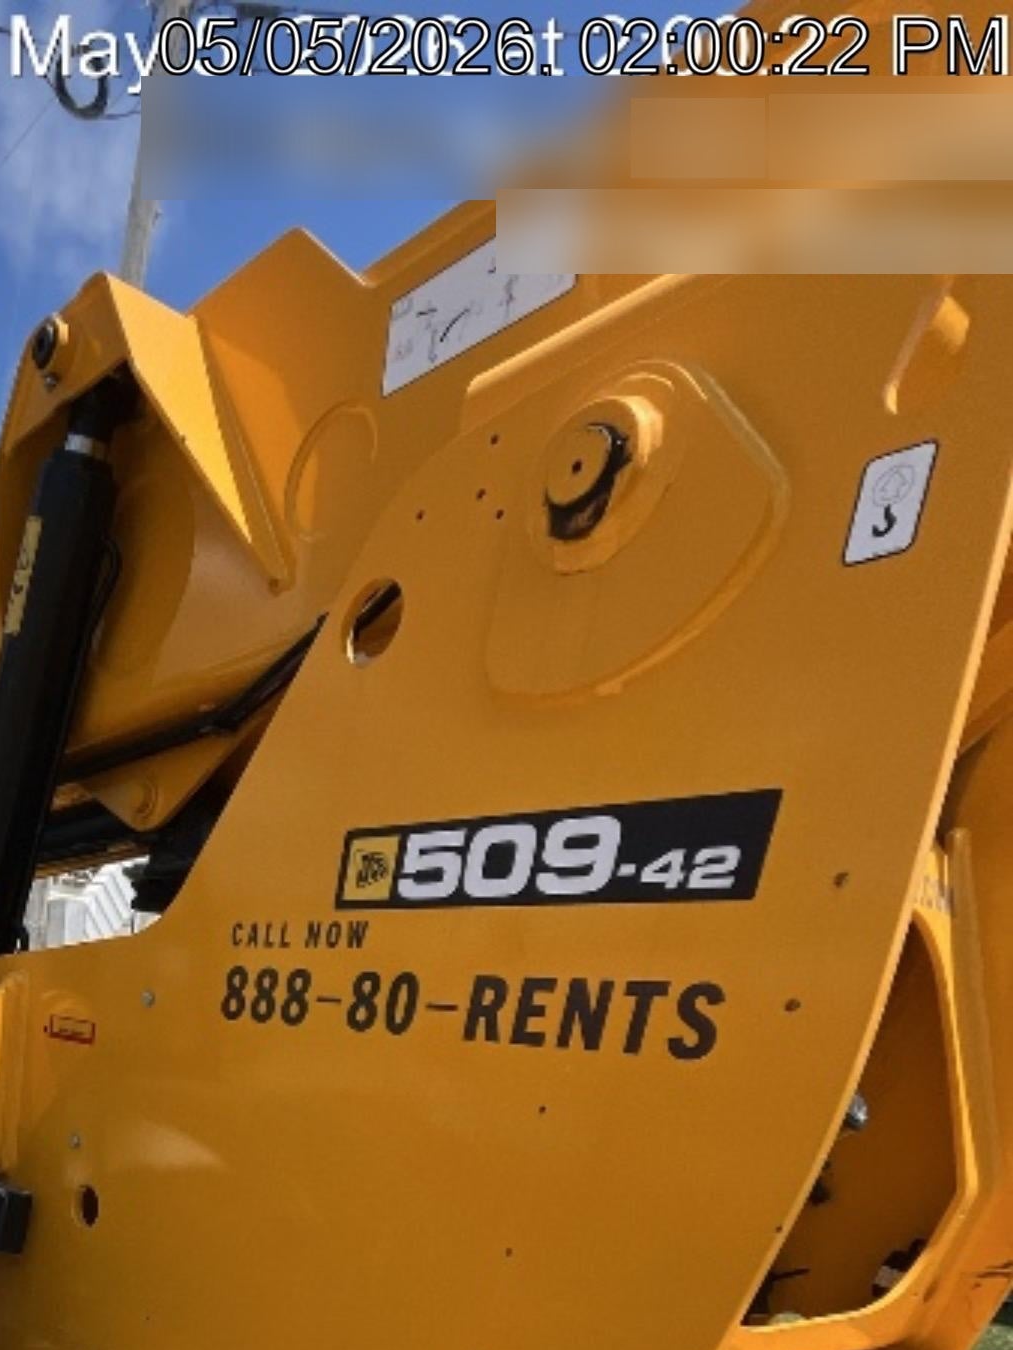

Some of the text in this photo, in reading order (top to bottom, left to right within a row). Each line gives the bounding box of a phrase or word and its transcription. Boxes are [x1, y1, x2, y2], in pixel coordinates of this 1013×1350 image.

[231, 921, 369, 949] CALL NOW
[220, 965, 726, 1060] 888-80-RENTS
